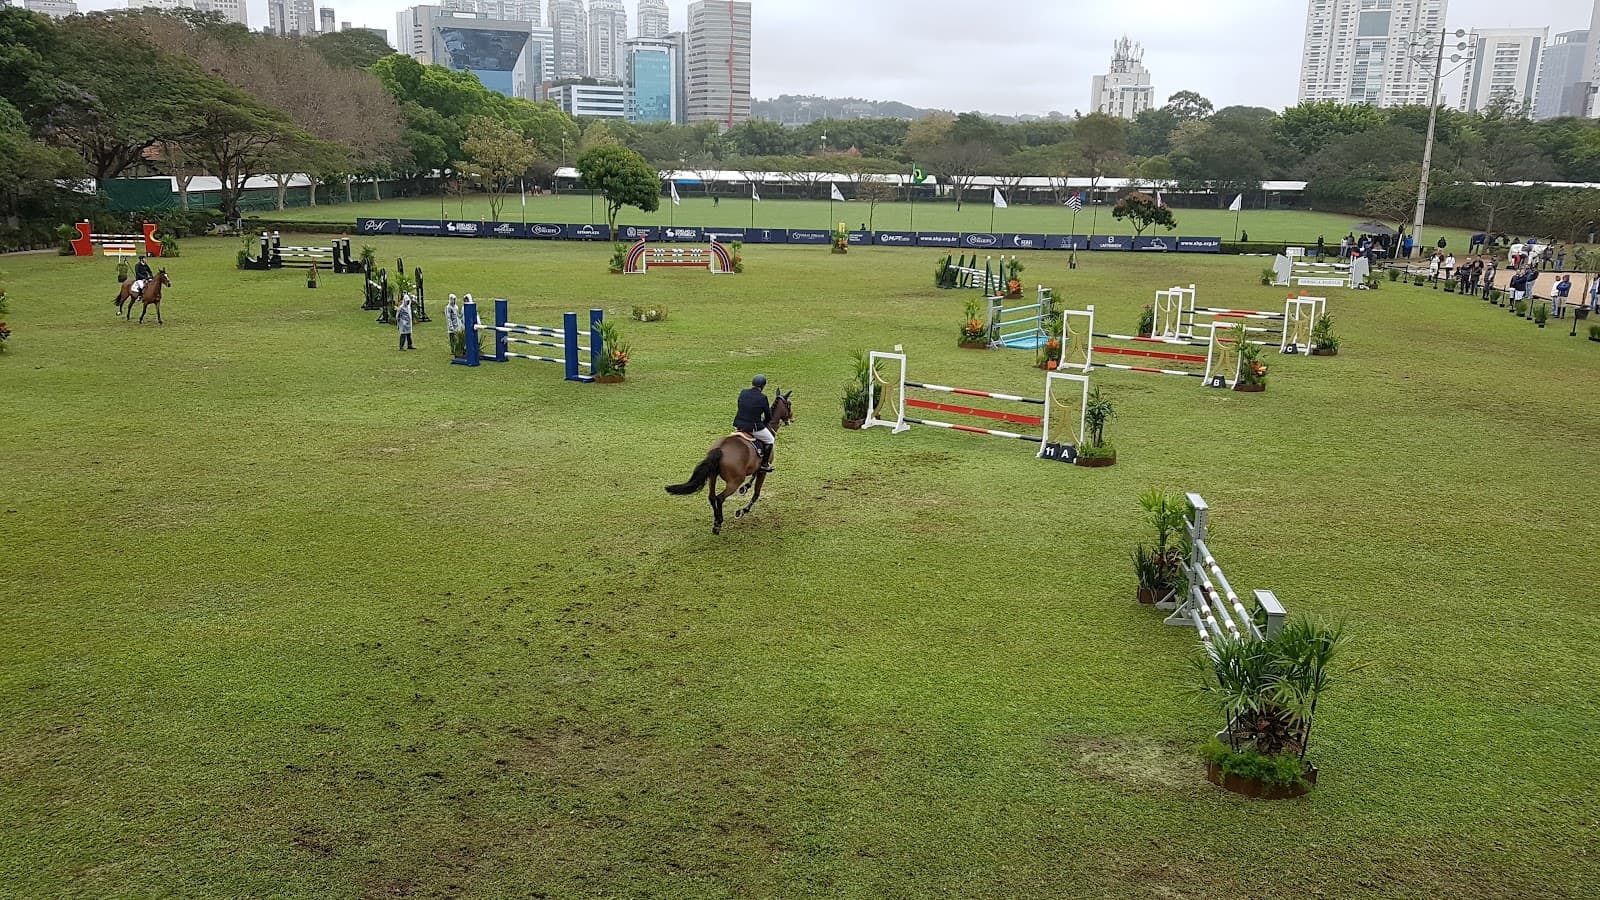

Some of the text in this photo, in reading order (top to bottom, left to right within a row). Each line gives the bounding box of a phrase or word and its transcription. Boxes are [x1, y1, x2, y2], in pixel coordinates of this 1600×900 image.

[1213, 379, 1220, 387] B
[1045, 446, 1069, 459] 11 A
